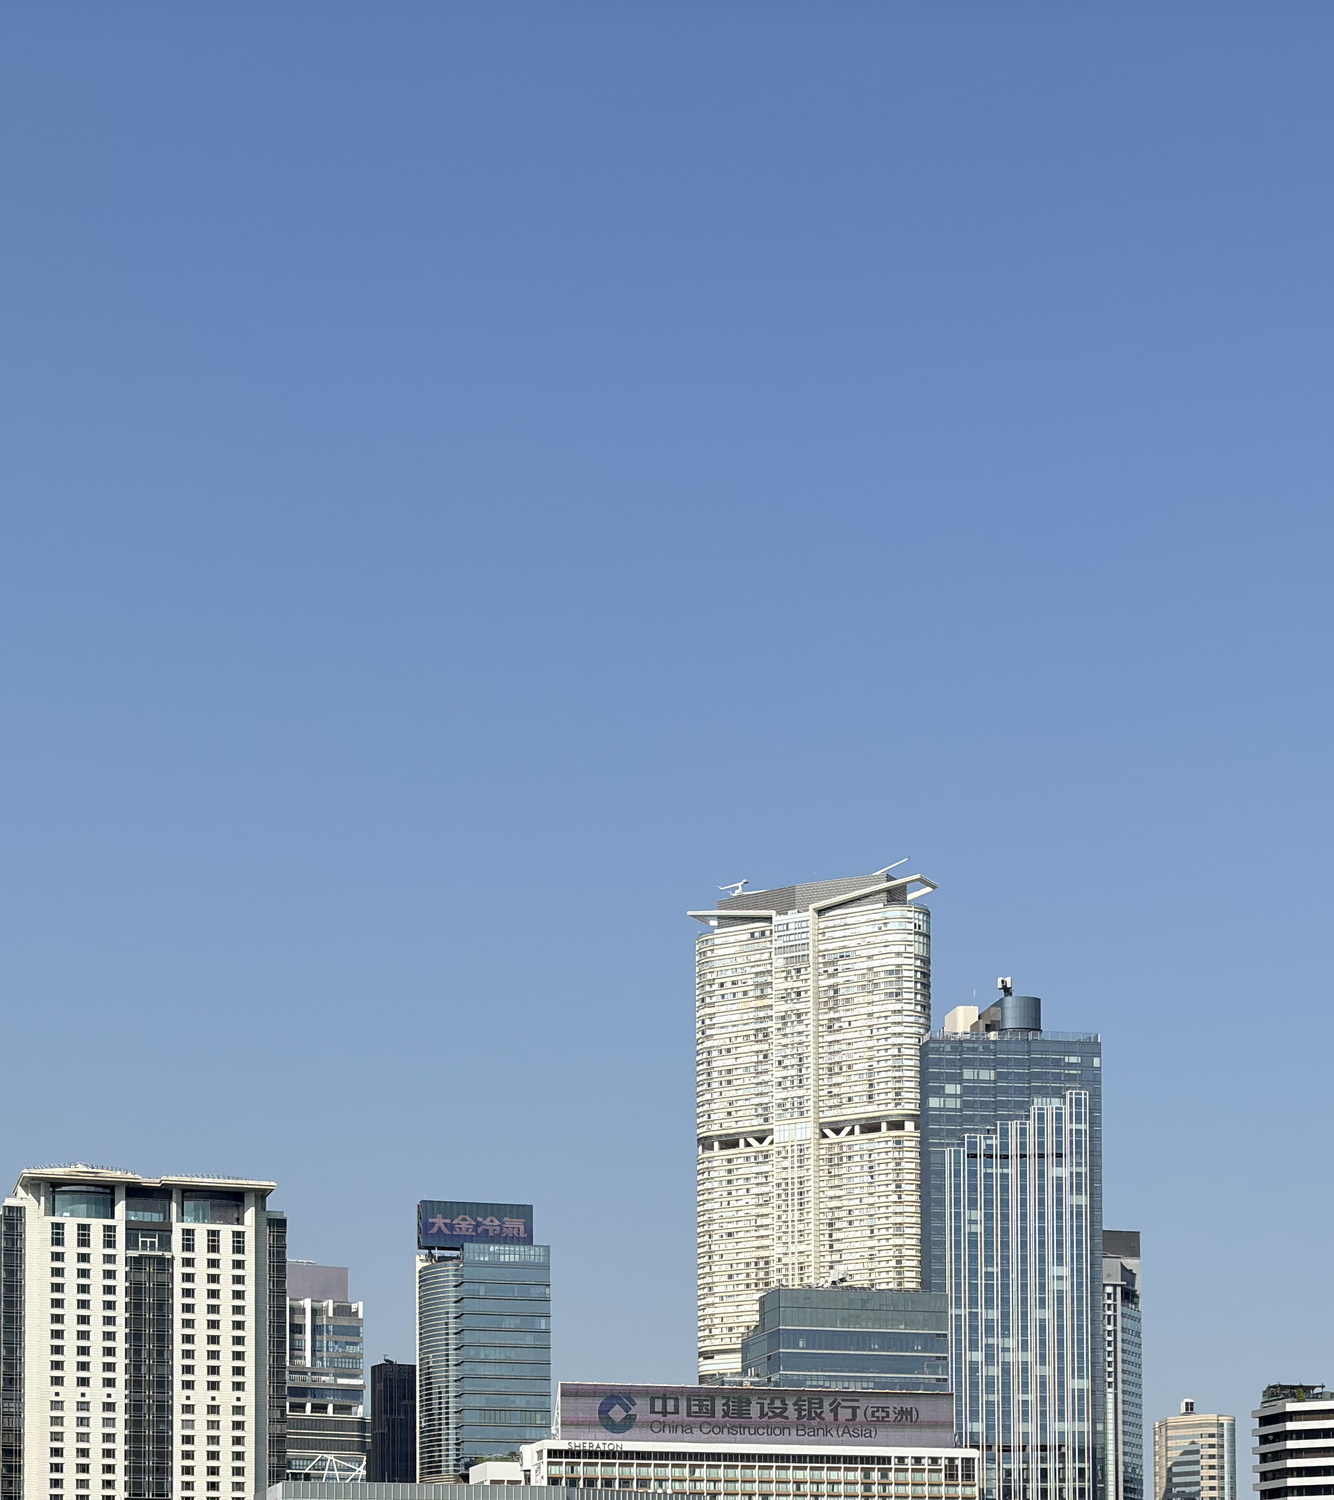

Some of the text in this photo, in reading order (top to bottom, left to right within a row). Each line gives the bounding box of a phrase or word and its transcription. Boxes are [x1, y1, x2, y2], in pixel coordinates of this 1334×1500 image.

[428, 1214, 527, 1238] 大金冷氣
[649, 1420, 878, 1439] China Construction Bank (Asia)
[567, 1441, 624, 1451] SHERATON
